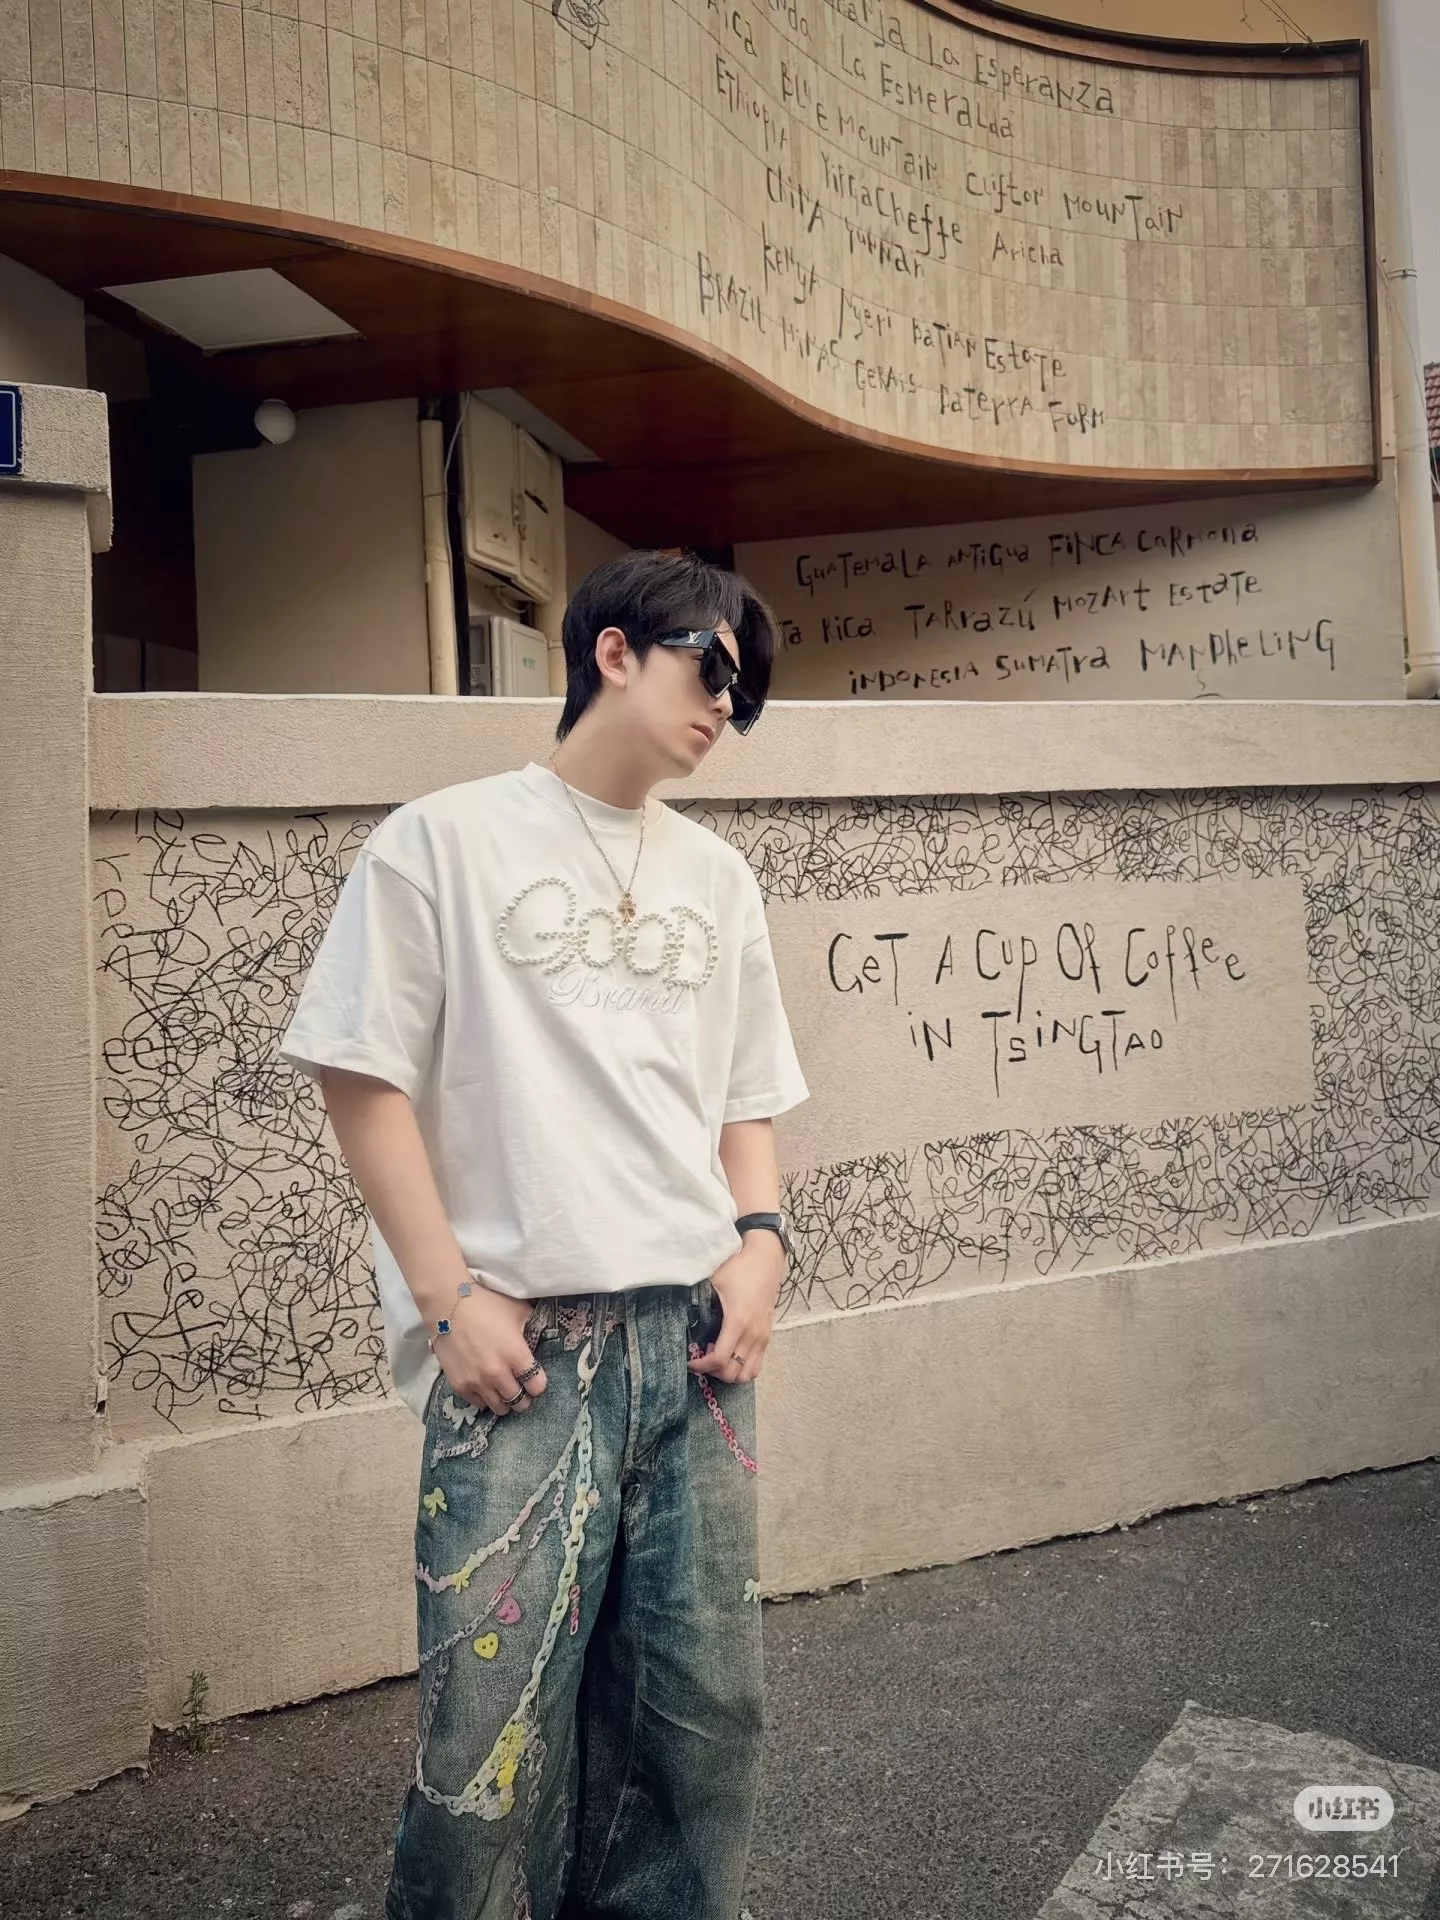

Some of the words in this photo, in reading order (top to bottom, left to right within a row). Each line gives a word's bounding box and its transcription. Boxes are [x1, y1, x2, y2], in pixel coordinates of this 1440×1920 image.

[546, 961, 689, 1015] Brand
[935, 935, 953, 985] A
[1125, 925, 1246, 1022] Coffee
